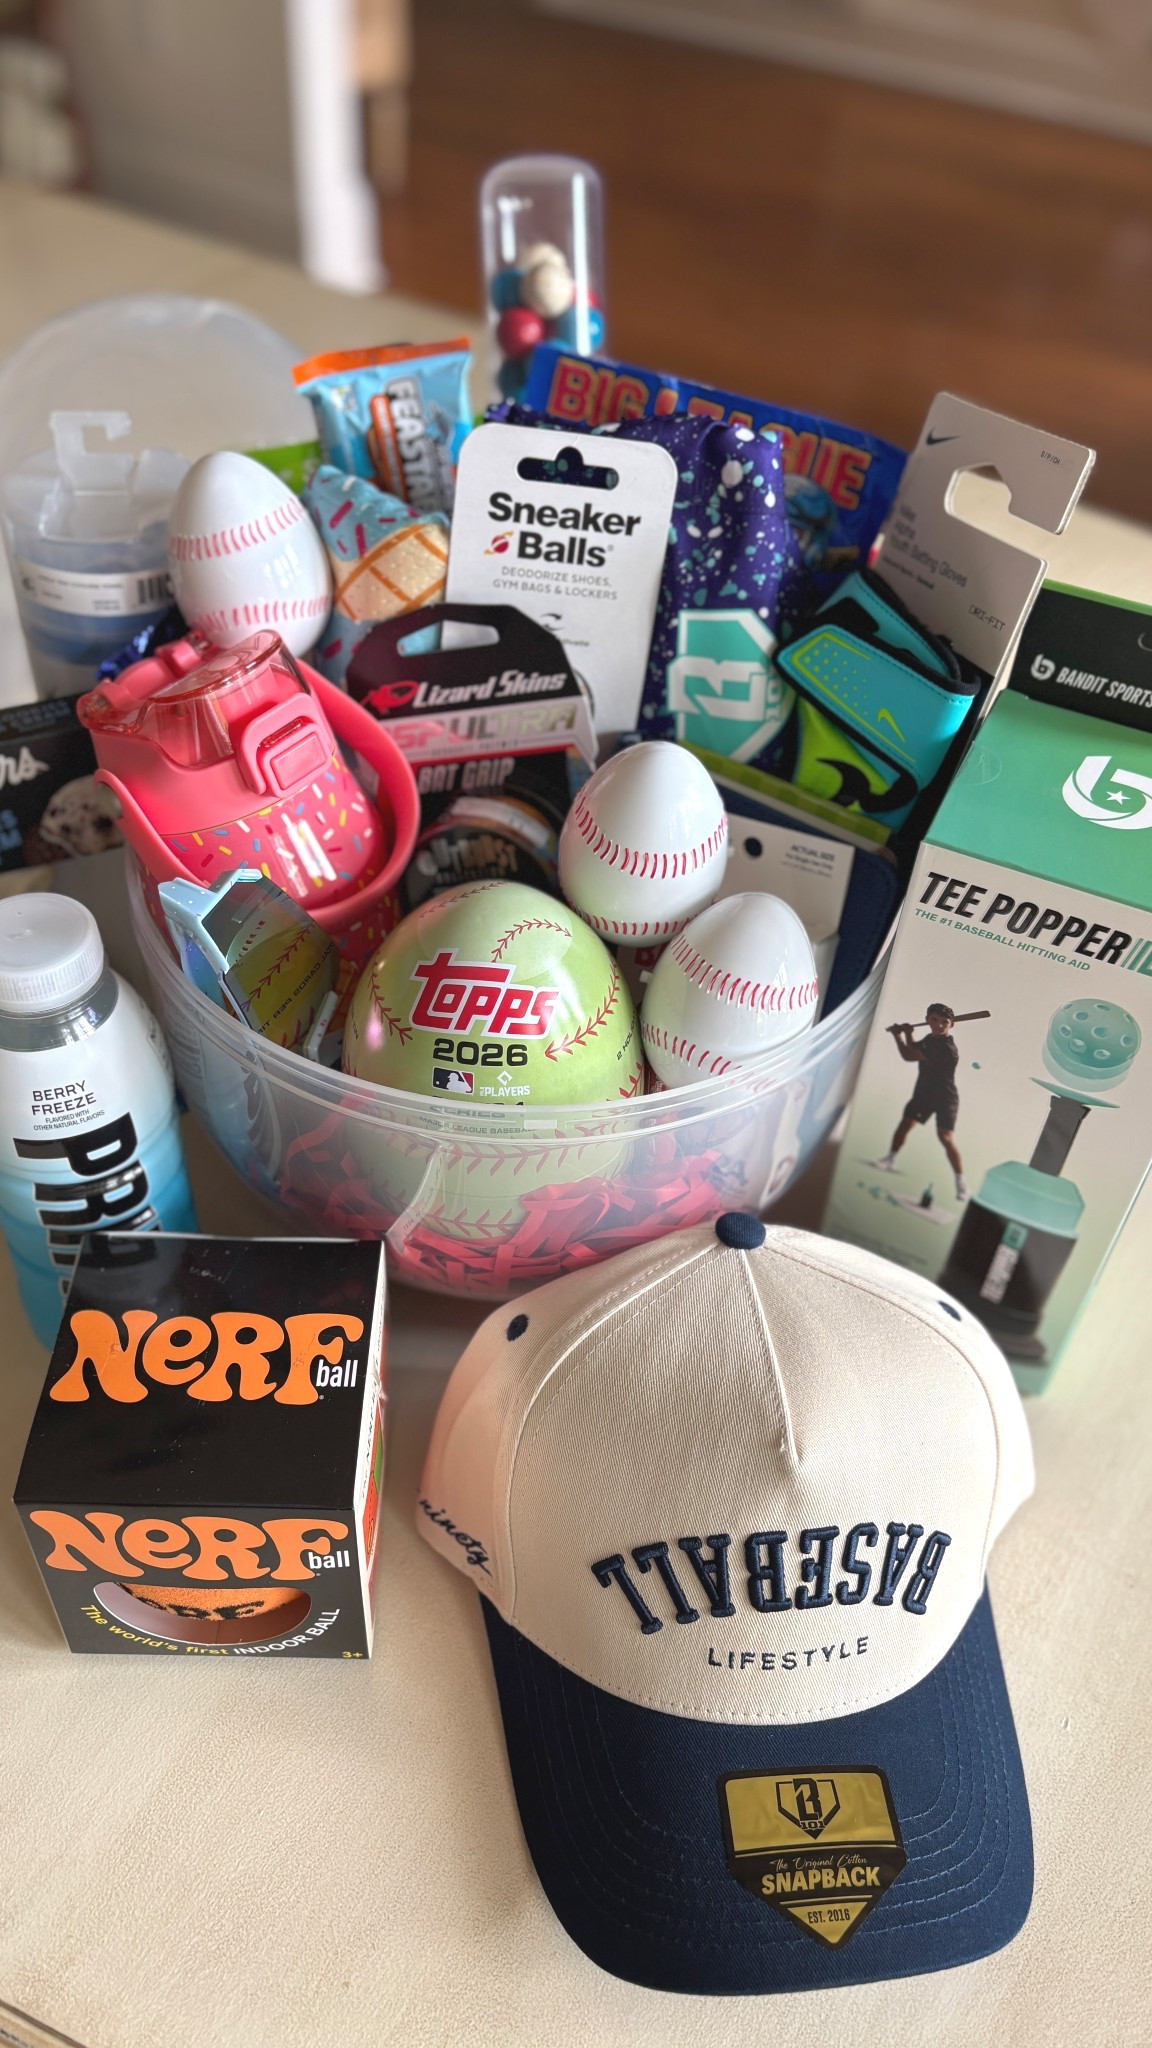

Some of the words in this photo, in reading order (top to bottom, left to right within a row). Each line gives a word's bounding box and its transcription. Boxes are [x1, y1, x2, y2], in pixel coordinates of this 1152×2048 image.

[546, 355, 649, 428] BIG
[487, 491, 641, 537] Sneaker
[492, 578, 520, 591] GYM
[520, 581, 552, 595] BAGS
[552, 584, 564, 595] &
[564, 586, 619, 601] LOCKERS
[501, 565, 570, 583] DEODORIZE
[571, 573, 613, 588] SHOES,
[968, 603, 1007, 632] DRI-FIT
[412, 677, 498, 708] Lizard
[494, 669, 567, 698] Skins
[1056, 666, 1110, 695] BANDIT
[1105, 681, 1152, 709] SPORTS
[449, 701, 577, 745] ULTRA
[417, 764, 460, 796] BAT
[460, 756, 516, 792] GRIP
[919, 871, 988, 919] TEE
[980, 892, 1134, 965] POPPER
[914, 908, 939, 923] THE
[939, 915, 954, 928] #1
[954, 921, 1016, 949] BASEBALL
[1016, 941, 1068, 965] HITTING
[1067, 957, 1092, 973] AID
[431, 1037, 529, 1068] 2026
[31, 1091, 98, 1116] FREEZE
[32, 1079, 87, 1103] BERRY
[484, 1085, 531, 1098] PLAYERS
[33, 1123, 53, 1132] OTHER
[53, 1118, 80, 1131] NATURAL
[79, 1109, 106, 1126] FLAVORS
[45, 1112, 71, 1124] FLAVORED
[72, 1108, 90, 1120] WITH
[452, 1123, 488, 1135] LEAGUE
[315, 1358, 359, 1389] ball
[419, 1499, 493, 1577] ninety
[307, 1550, 351, 1571] ball
[591, 1521, 952, 1636] BASEBALL
[81, 1604, 108, 1625] The
[108, 1625, 179, 1652] world's
[186, 1645, 229, 1656] first
[233, 1631, 312, 1656] INDOOR
[309, 1608, 341, 1637] BALL
[342, 1651, 363, 1660] 3+
[707, 1635, 870, 1672] LIFESTYLE
[769, 1857, 788, 1874] The
[793, 1854, 834, 1871] Original
[836, 1853, 868, 1869] Cotton
[761, 1866, 881, 1896] SNAPBACK
[807, 1911, 827, 1925] EST.
[828, 1907, 851, 1923] 2016
